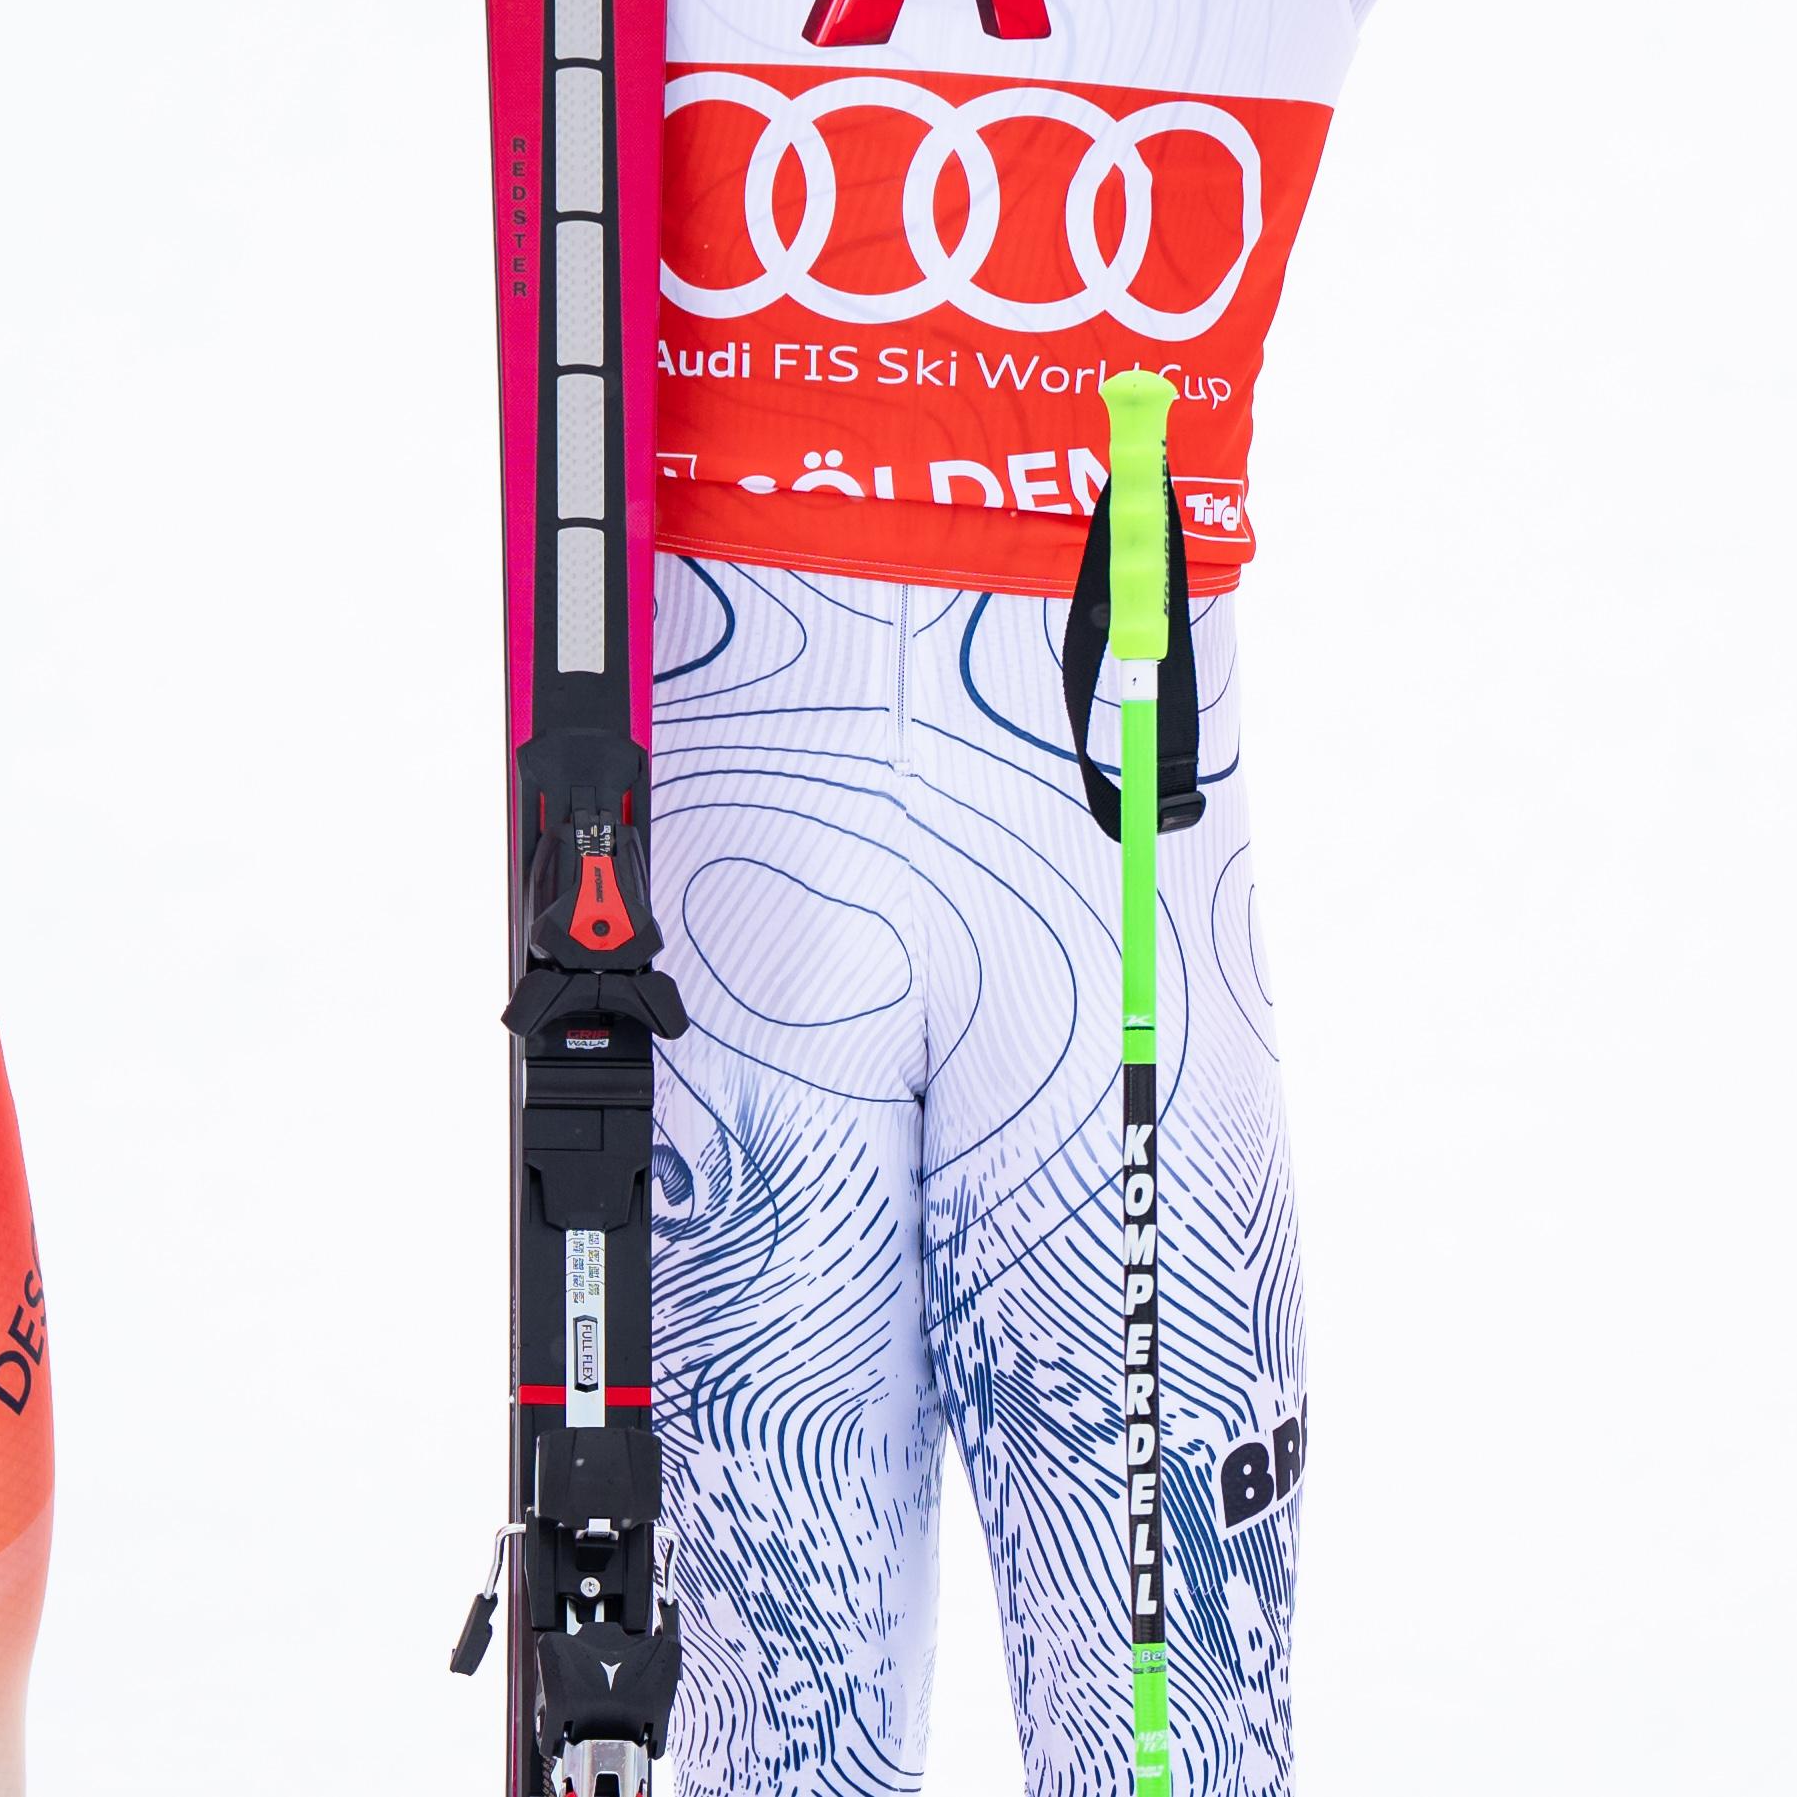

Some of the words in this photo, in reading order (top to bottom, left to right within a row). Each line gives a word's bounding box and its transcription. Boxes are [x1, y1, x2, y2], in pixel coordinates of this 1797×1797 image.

[511, 137, 527, 297] REDSTER
[656, 339, 752, 379] Audi
[773, 343, 859, 383] FIS
[877, 348, 958, 388] Ski
[975, 350, 1139, 395] Worl
[1185, 493, 1242, 531] Tirol
[567, 1030, 609, 1040] GRIP
[567, 1039, 608, 1048] WALK
[581, 1324, 592, 1349] FULL
[581, 1352, 592, 1382] FLEX
[1123, 1124, 1158, 1616] KOMPERDELL
